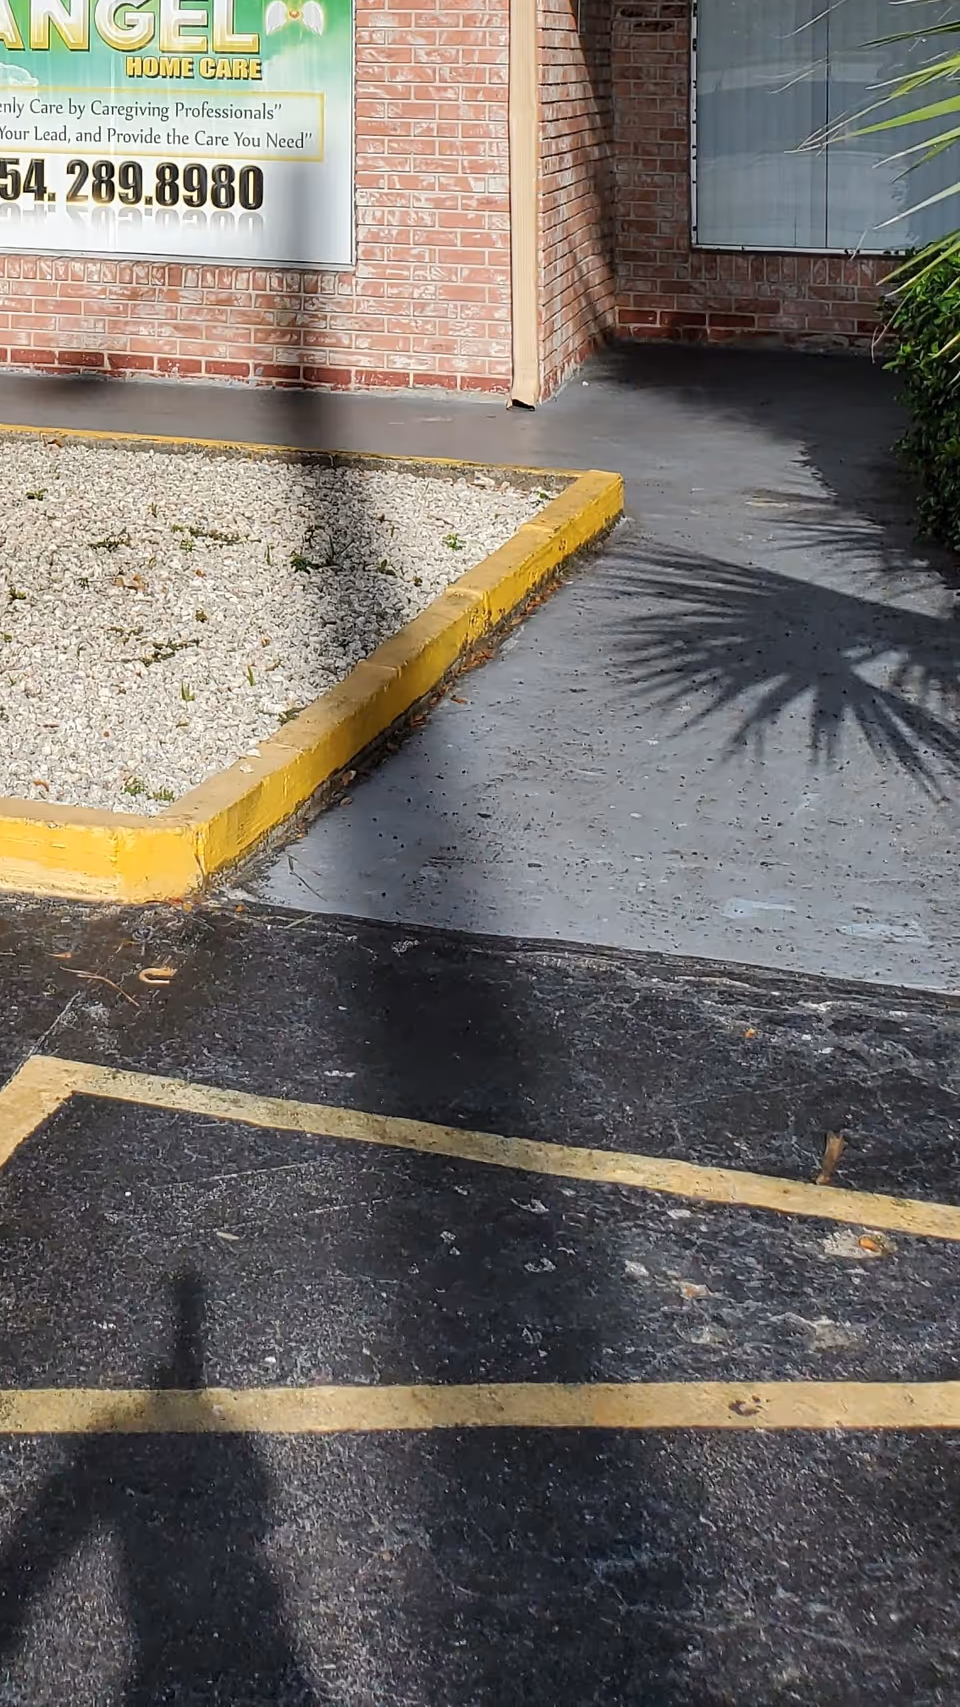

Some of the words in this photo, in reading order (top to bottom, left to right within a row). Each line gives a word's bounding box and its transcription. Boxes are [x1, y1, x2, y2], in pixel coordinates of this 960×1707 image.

[126, 56, 194, 78] HOME
[199, 57, 263, 80] CARE
[29, 99, 63, 116] Care
[68, 98, 86, 120] by
[90, 100, 170, 123] Caregiving
[34, 125, 71, 146] Lead,
[75, 128, 102, 144] and
[107, 128, 161, 147] Provide
[166, 129, 190, 147] the
[194, 130, 230, 148] Care
[233, 131, 262, 149] You
